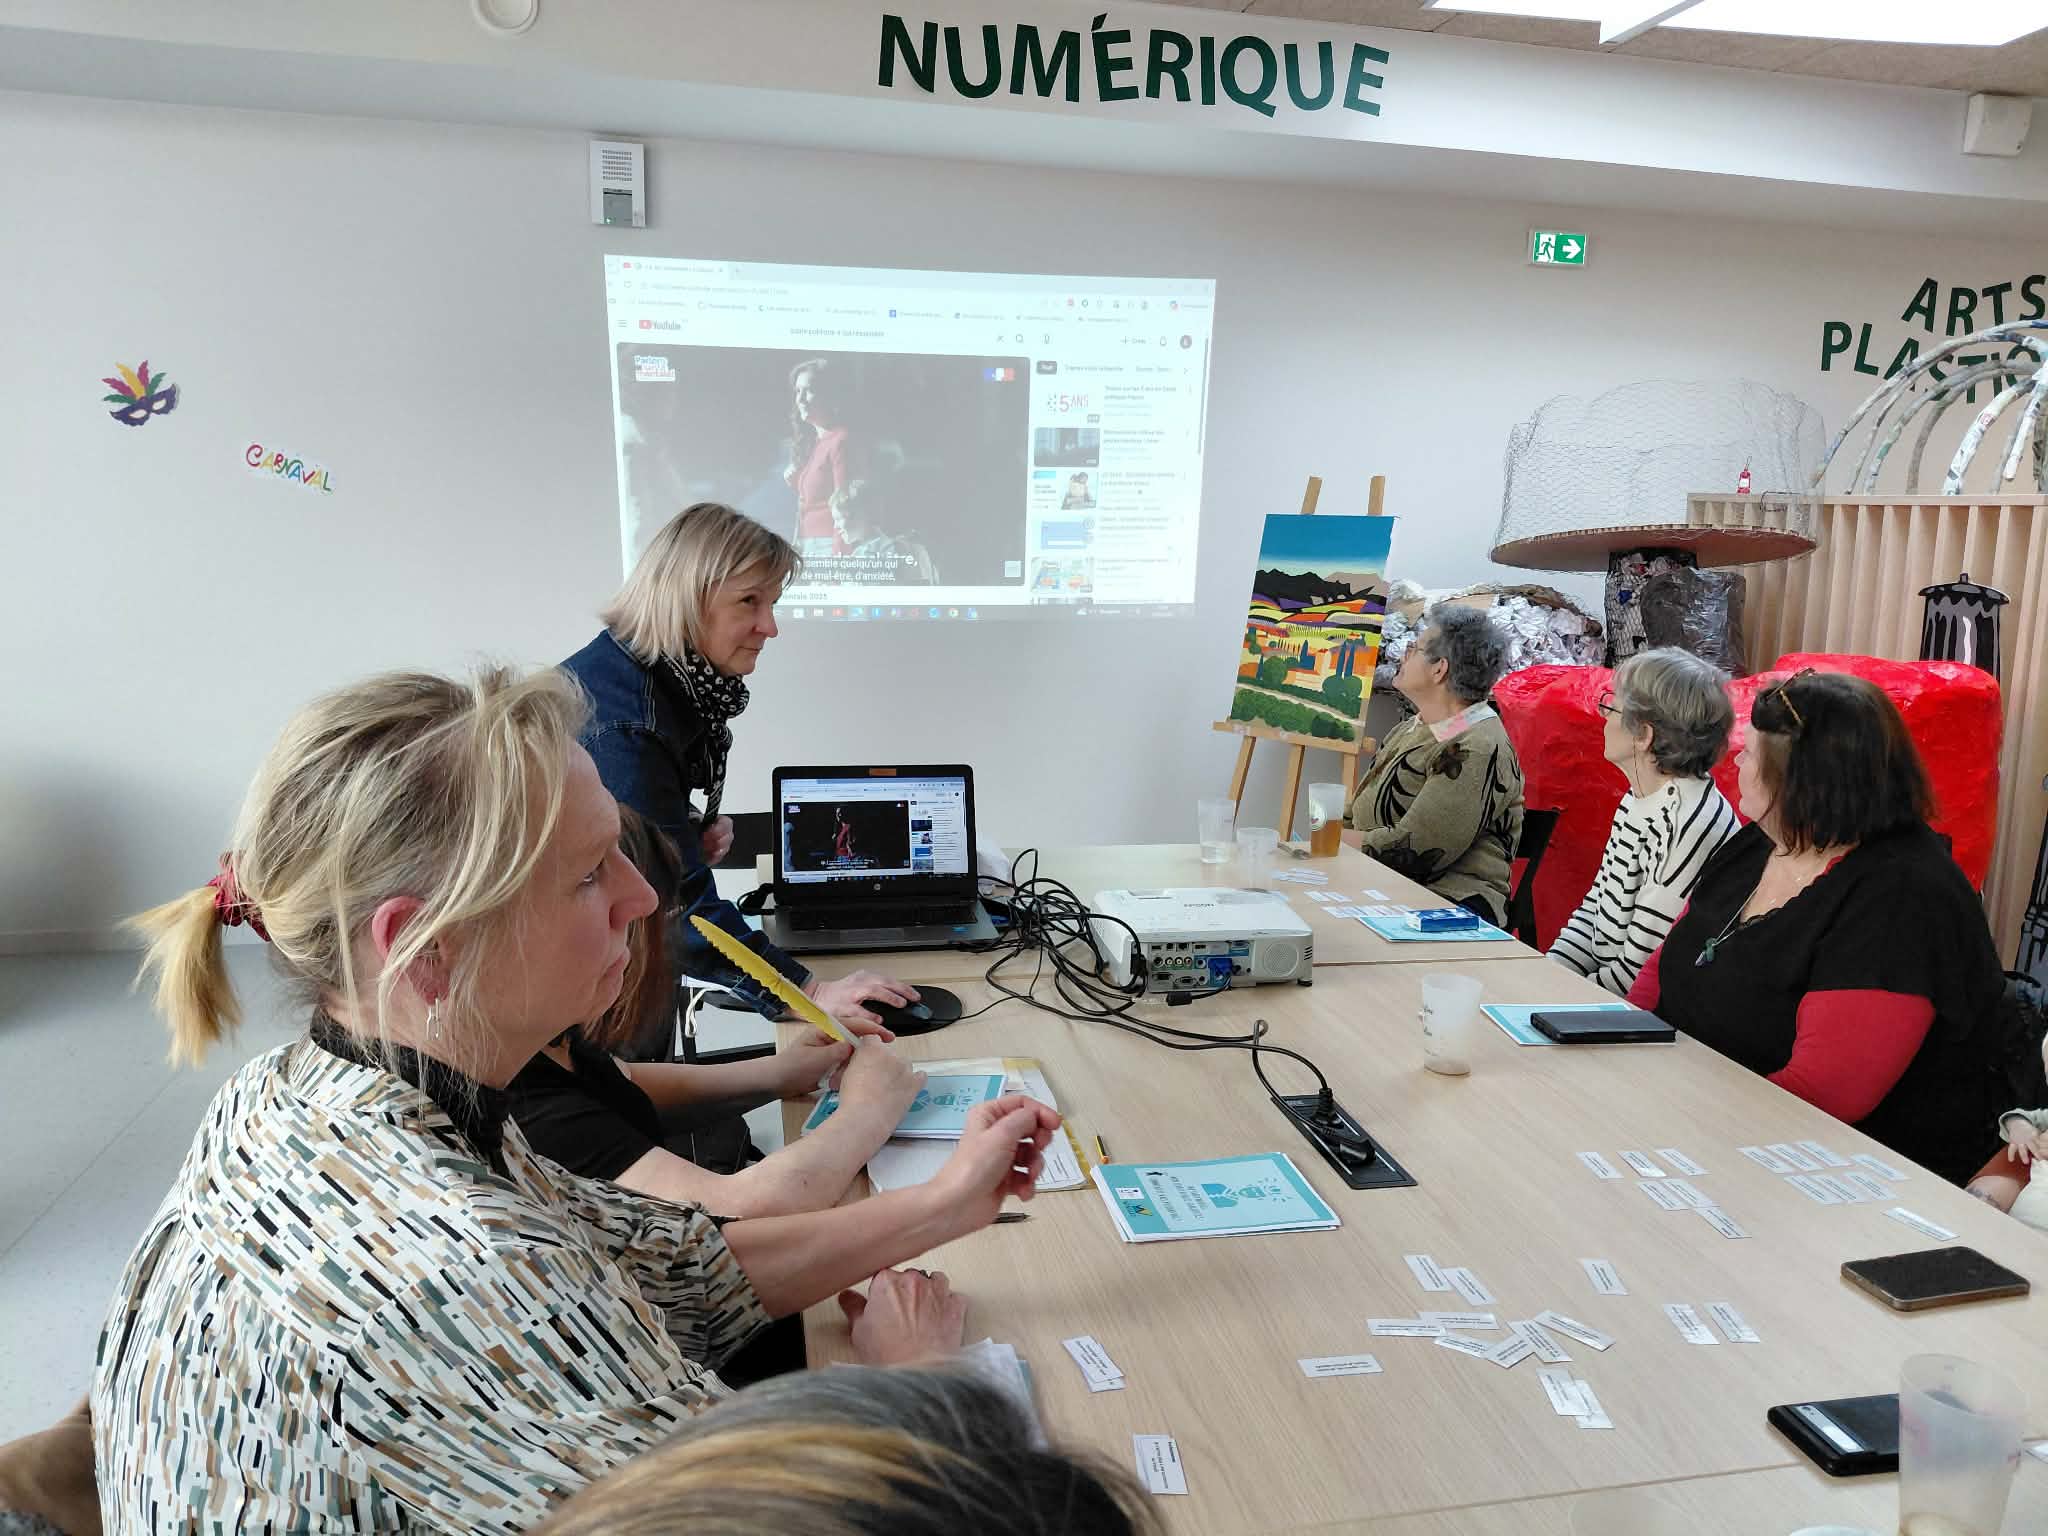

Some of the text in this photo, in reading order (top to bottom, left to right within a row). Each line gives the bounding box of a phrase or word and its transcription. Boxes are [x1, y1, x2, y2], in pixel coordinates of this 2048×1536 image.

[878, 13, 1390, 118] NUMÉRIQUE
[1901, 275, 2046, 337] ARTS
[246, 444, 331, 491] CARNAVAL
[884, 558, 899, 571] qui
